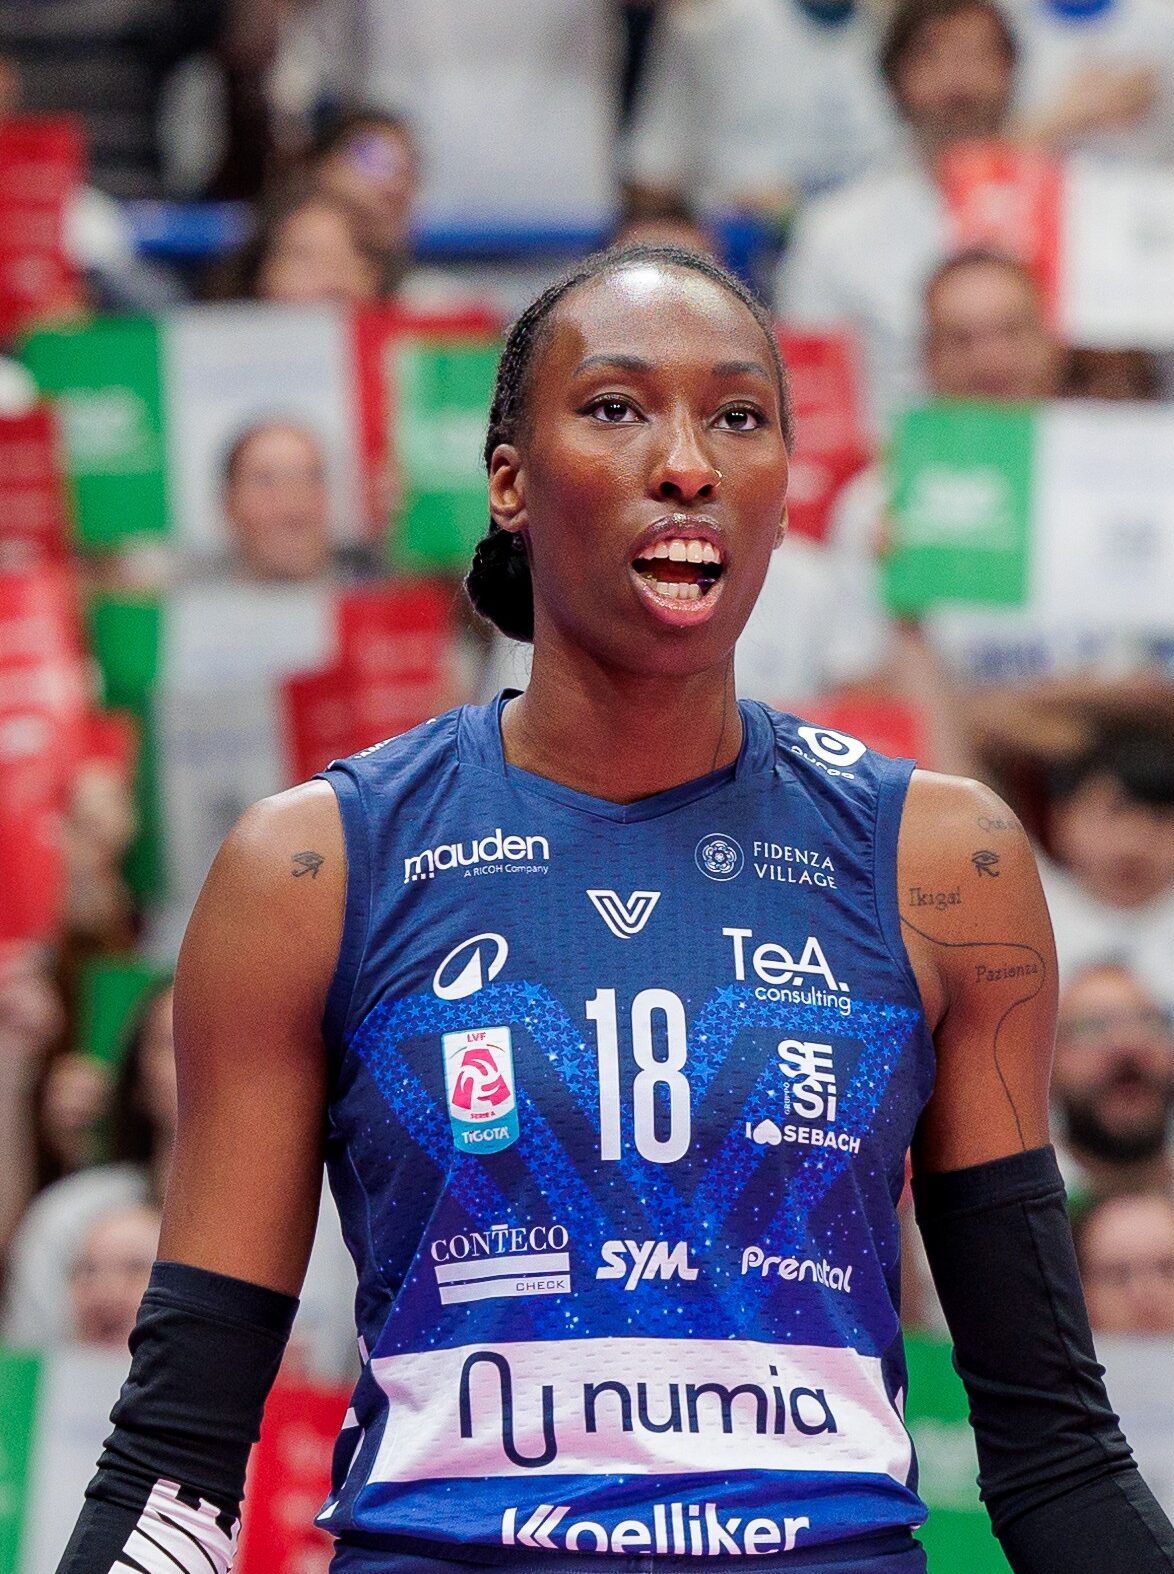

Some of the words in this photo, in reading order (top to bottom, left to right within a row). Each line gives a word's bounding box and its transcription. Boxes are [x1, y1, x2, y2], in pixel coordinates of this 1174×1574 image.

[404, 828, 550, 881] mauden
[753, 841, 835, 872] FIDENZA
[464, 869, 472, 878] A
[473, 865, 504, 877] RICOH
[504, 864, 549, 875] Company
[753, 863, 838, 889] VILLAGE
[754, 986, 851, 1016] consulting
[466, 1031, 487, 1043] LVF
[585, 988, 692, 1164] 18
[783, 1124, 862, 1155] SEBACH
[430, 1223, 570, 1262] CONTECO
[595, 1239, 701, 1291] SYM
[515, 1280, 566, 1292] CHECK
[583, 1364, 838, 1436] numia
[501, 1502, 810, 1556] Koelliker
